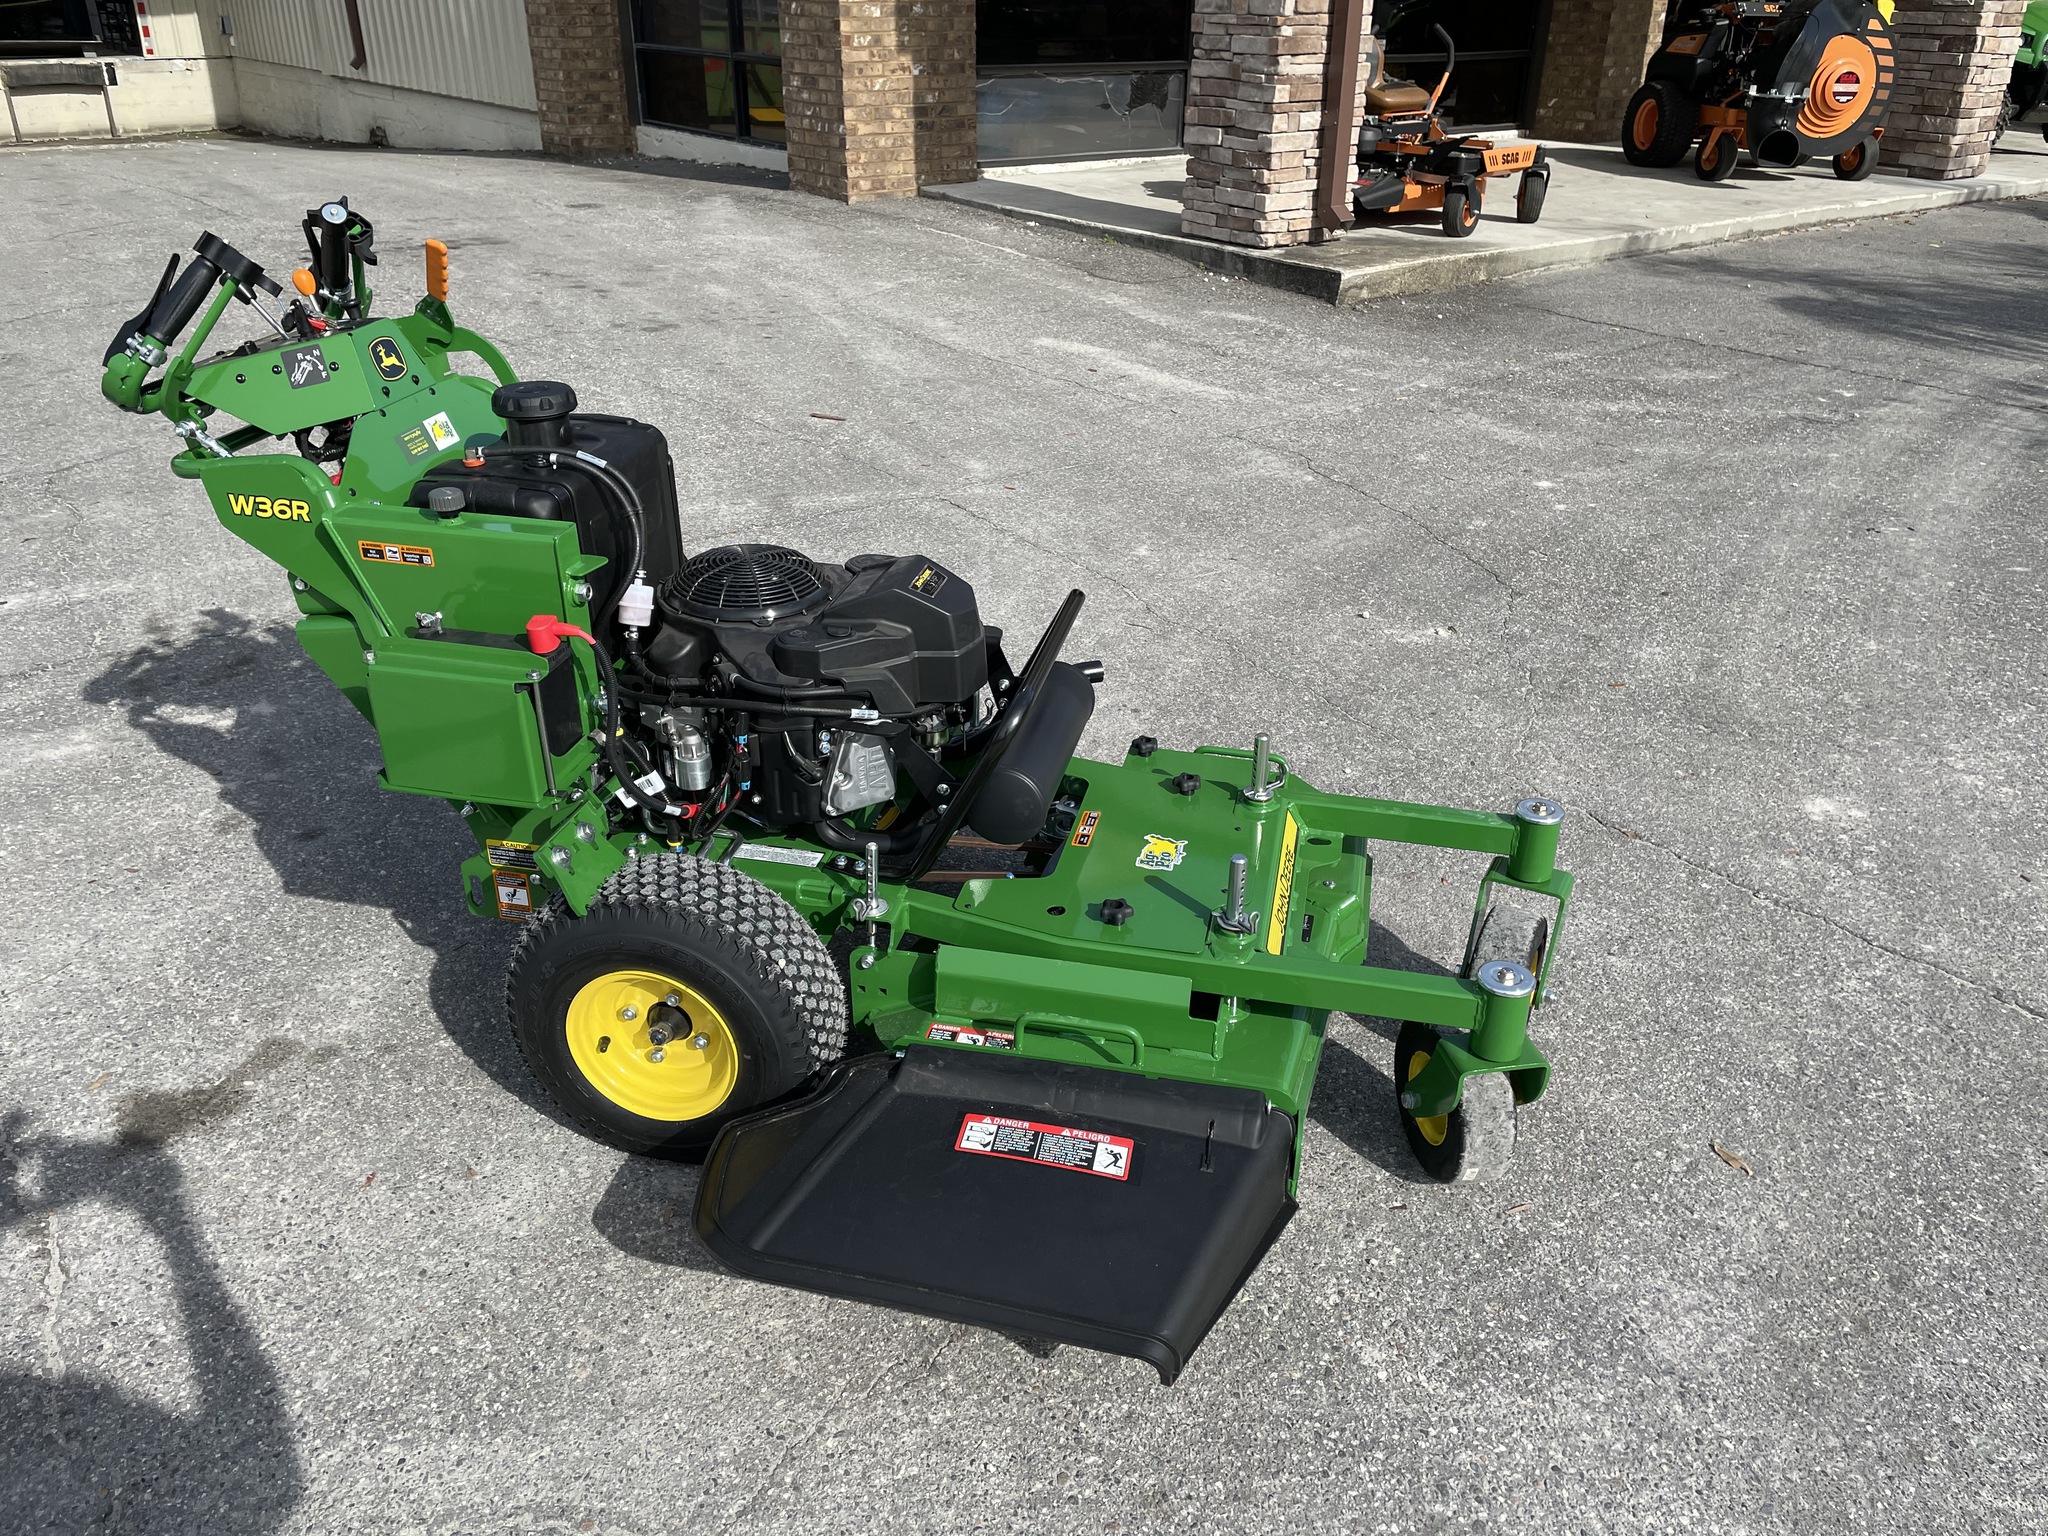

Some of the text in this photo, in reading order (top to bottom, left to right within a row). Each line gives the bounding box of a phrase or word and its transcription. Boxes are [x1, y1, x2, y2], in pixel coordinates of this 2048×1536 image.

[1501, 152, 1519, 165] SCAG
[296, 348, 320, 361] R N
[321, 371, 328, 379] F
[226, 493, 312, 523] W36R
[505, 842, 532, 850] CAUTION
[1275, 844, 1294, 934] JOHN DEERE
[993, 1117, 1030, 1129] DANGER
[1072, 1130, 1111, 1143] PELIGRO
